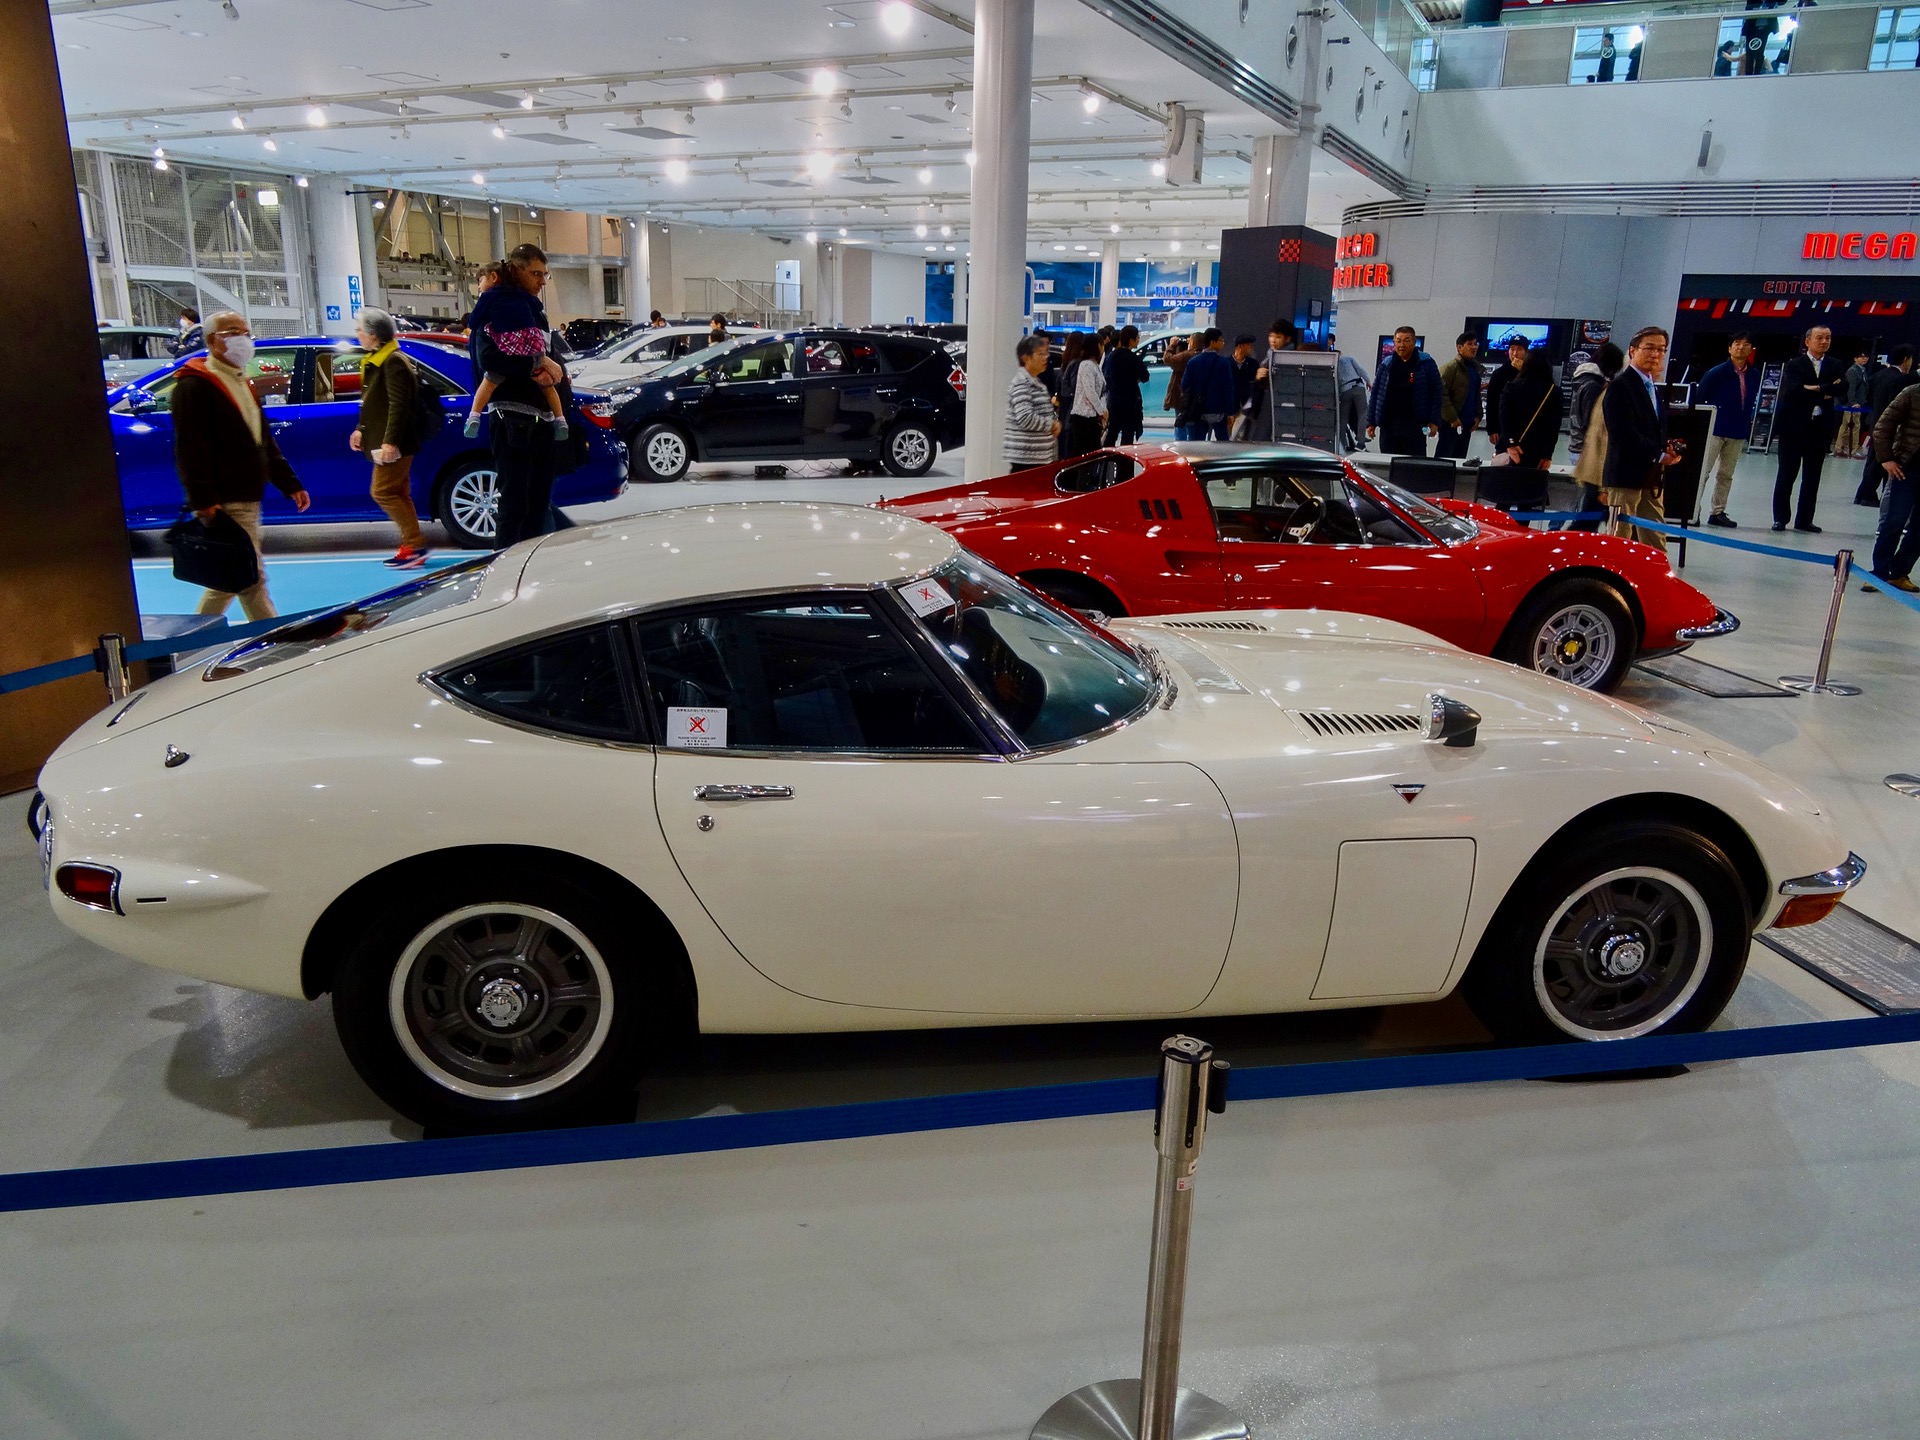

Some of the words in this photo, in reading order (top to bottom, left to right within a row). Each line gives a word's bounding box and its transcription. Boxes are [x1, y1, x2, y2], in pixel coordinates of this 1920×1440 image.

[1802, 231, 1918, 259] MEGA
[1155, 286, 1190, 298] RIDE
[1763, 281, 1826, 294] ENTER
[1162, 299, 1214, 308] 試乗ステーション
